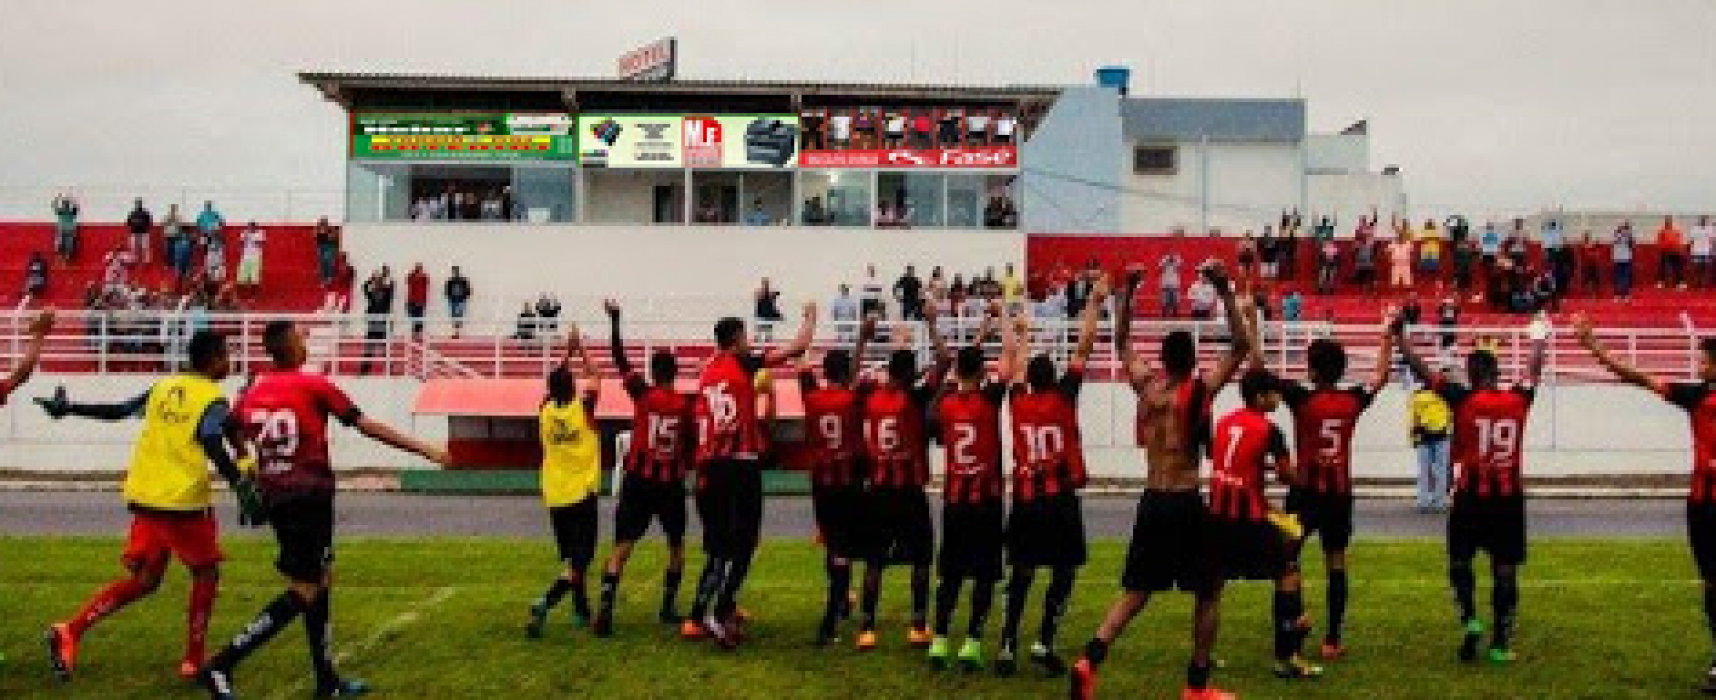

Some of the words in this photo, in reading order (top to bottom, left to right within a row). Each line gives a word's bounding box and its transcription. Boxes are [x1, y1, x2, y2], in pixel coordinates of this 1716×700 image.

[820, 415, 842, 449] 9
[954, 423, 977, 463] 2
[1019, 423, 1064, 462] 10
[1320, 418, 1342, 456] 5
[1474, 418, 1516, 457] 19
